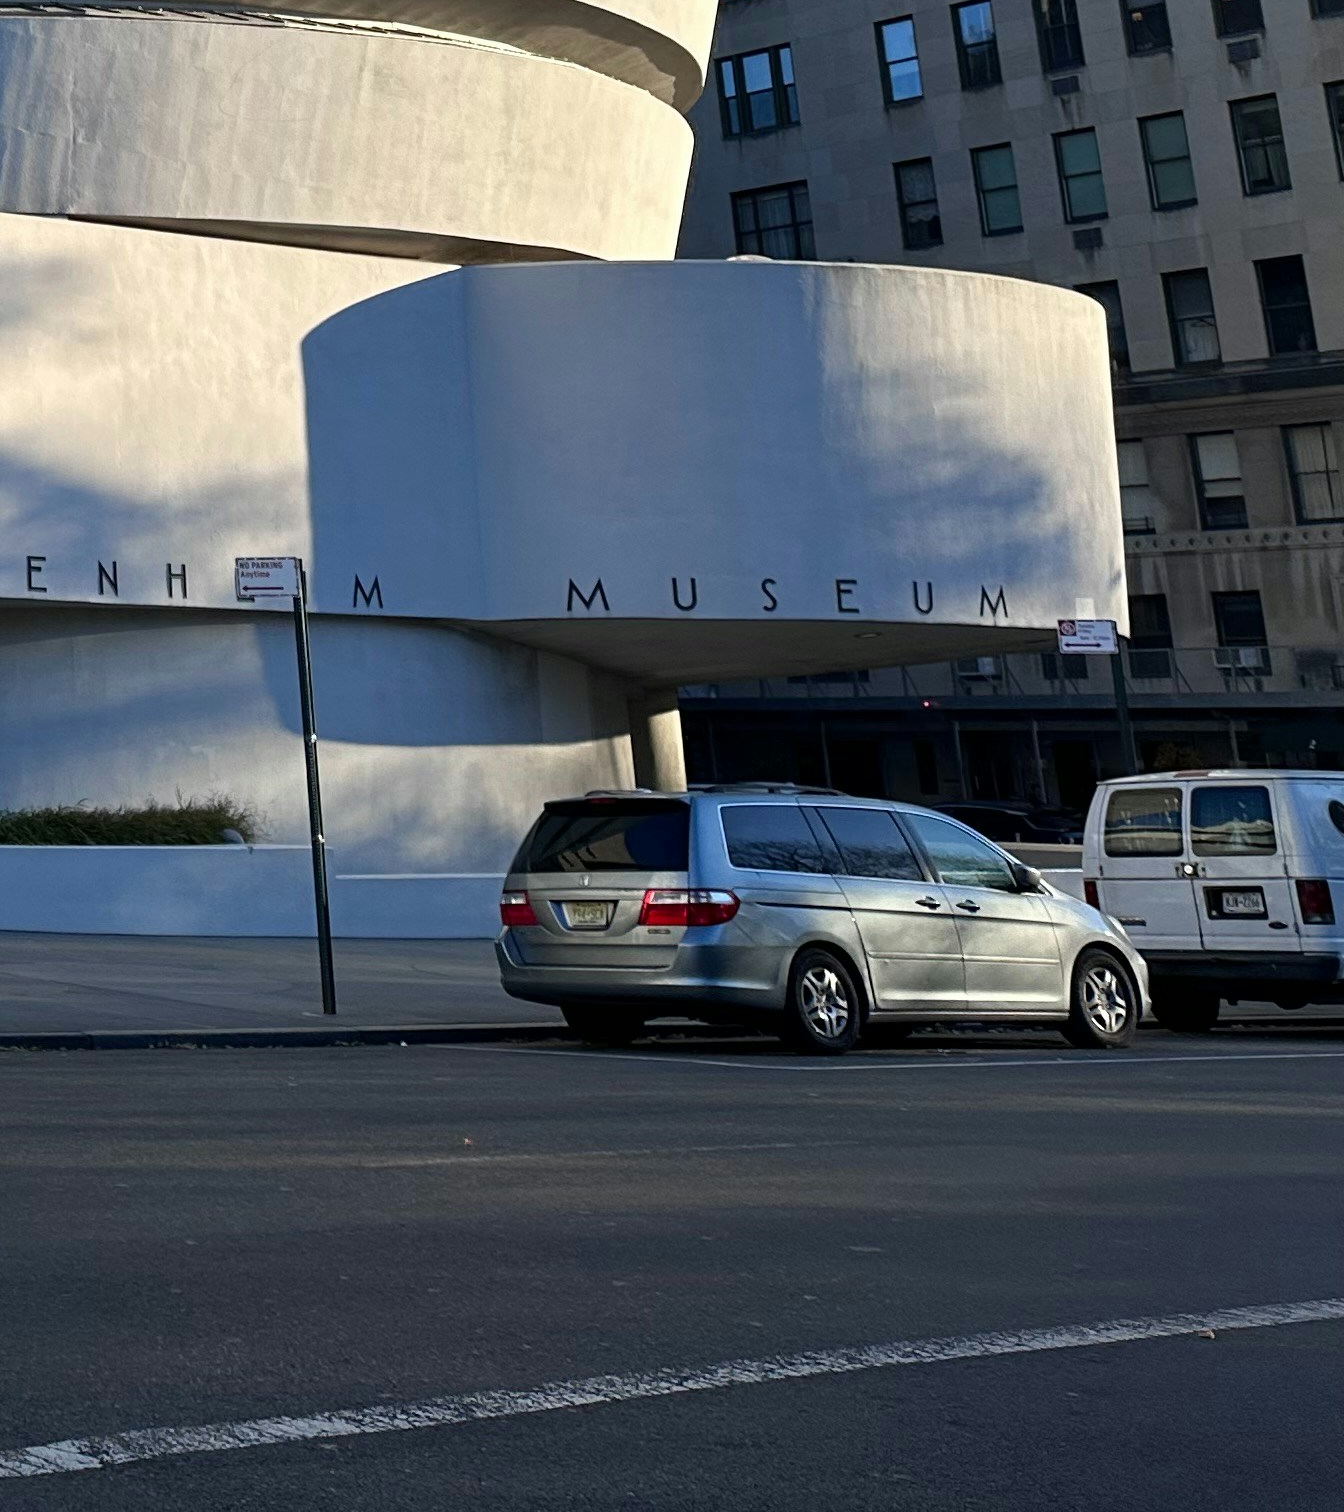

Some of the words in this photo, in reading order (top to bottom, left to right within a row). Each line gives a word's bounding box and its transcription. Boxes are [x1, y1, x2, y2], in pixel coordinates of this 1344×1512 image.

[239, 561, 250, 569] NO
[252, 561, 284, 569] PARKING
[240, 570, 271, 579] Anytime
[565, 577, 1010, 618] MUSEUM
